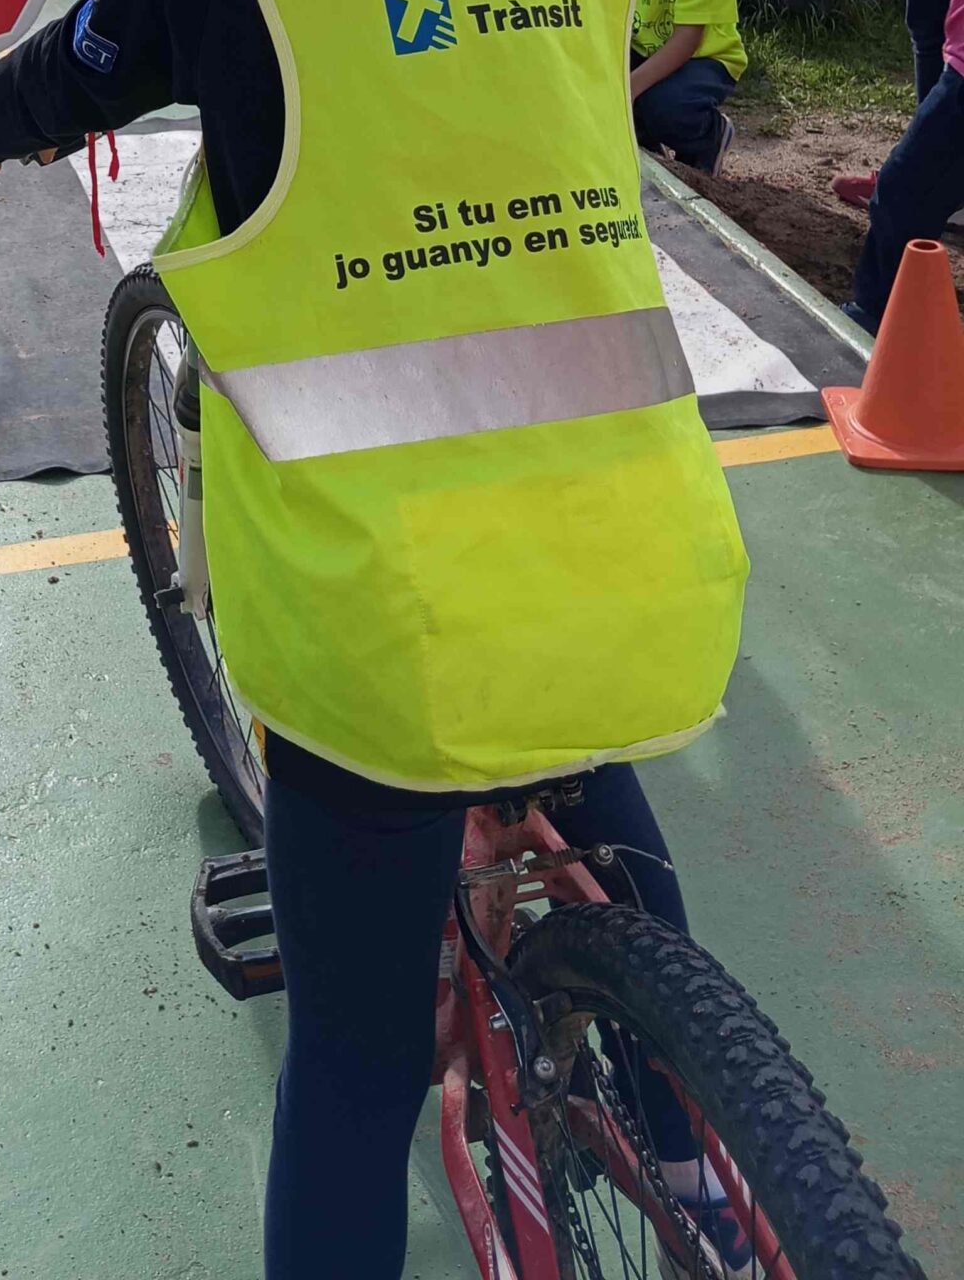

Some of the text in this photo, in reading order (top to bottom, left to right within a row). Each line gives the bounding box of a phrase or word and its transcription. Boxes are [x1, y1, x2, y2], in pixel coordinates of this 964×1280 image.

[413, 202, 448, 233] Si
[458, 199, 495, 226] tu
[507, 192, 562, 220] em
[334, 254, 370, 289] jo
[382, 235, 512, 281] guanyo
[524, 227, 568, 253] en
